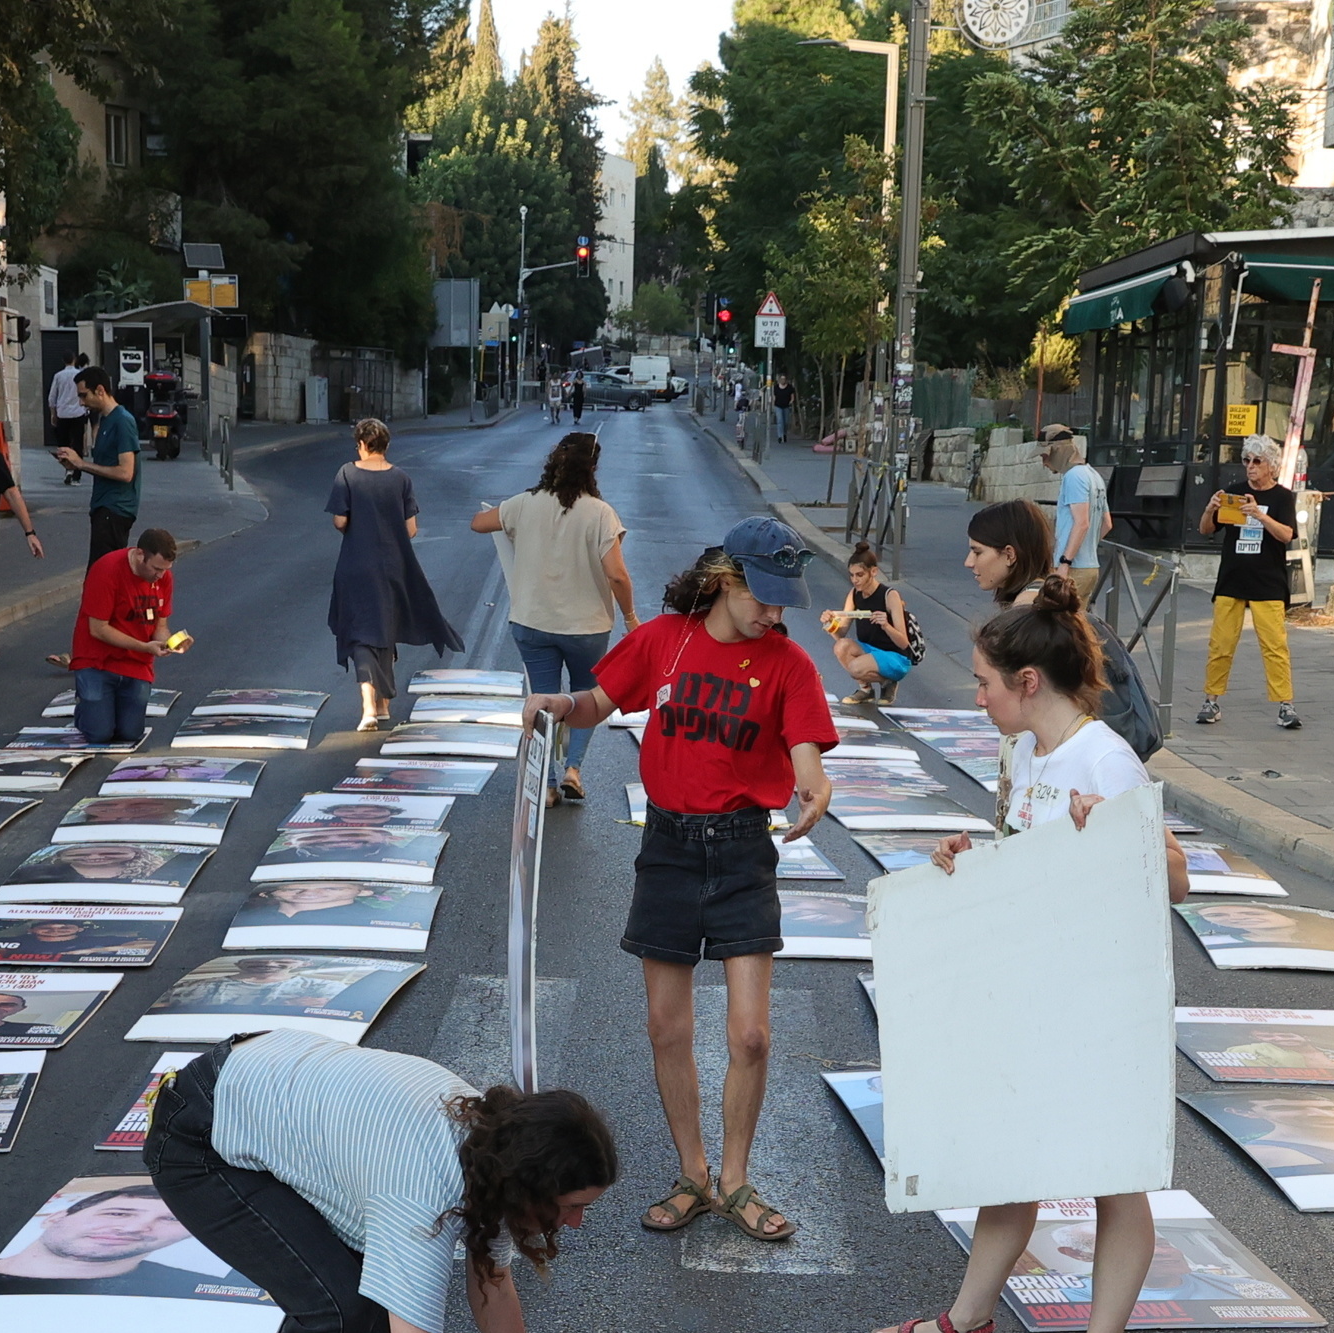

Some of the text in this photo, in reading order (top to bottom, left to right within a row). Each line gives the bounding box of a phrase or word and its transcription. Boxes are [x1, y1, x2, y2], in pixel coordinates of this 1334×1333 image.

[674, 672, 752, 716] כולנו
[659, 705, 761, 752] חטופים
[1035, 783, 1052, 800] 329
[1059, 1207, 1090, 1218] (72)
[1007, 1275, 1088, 1290] BRING
[1019, 1289, 1069, 1304] HIM
